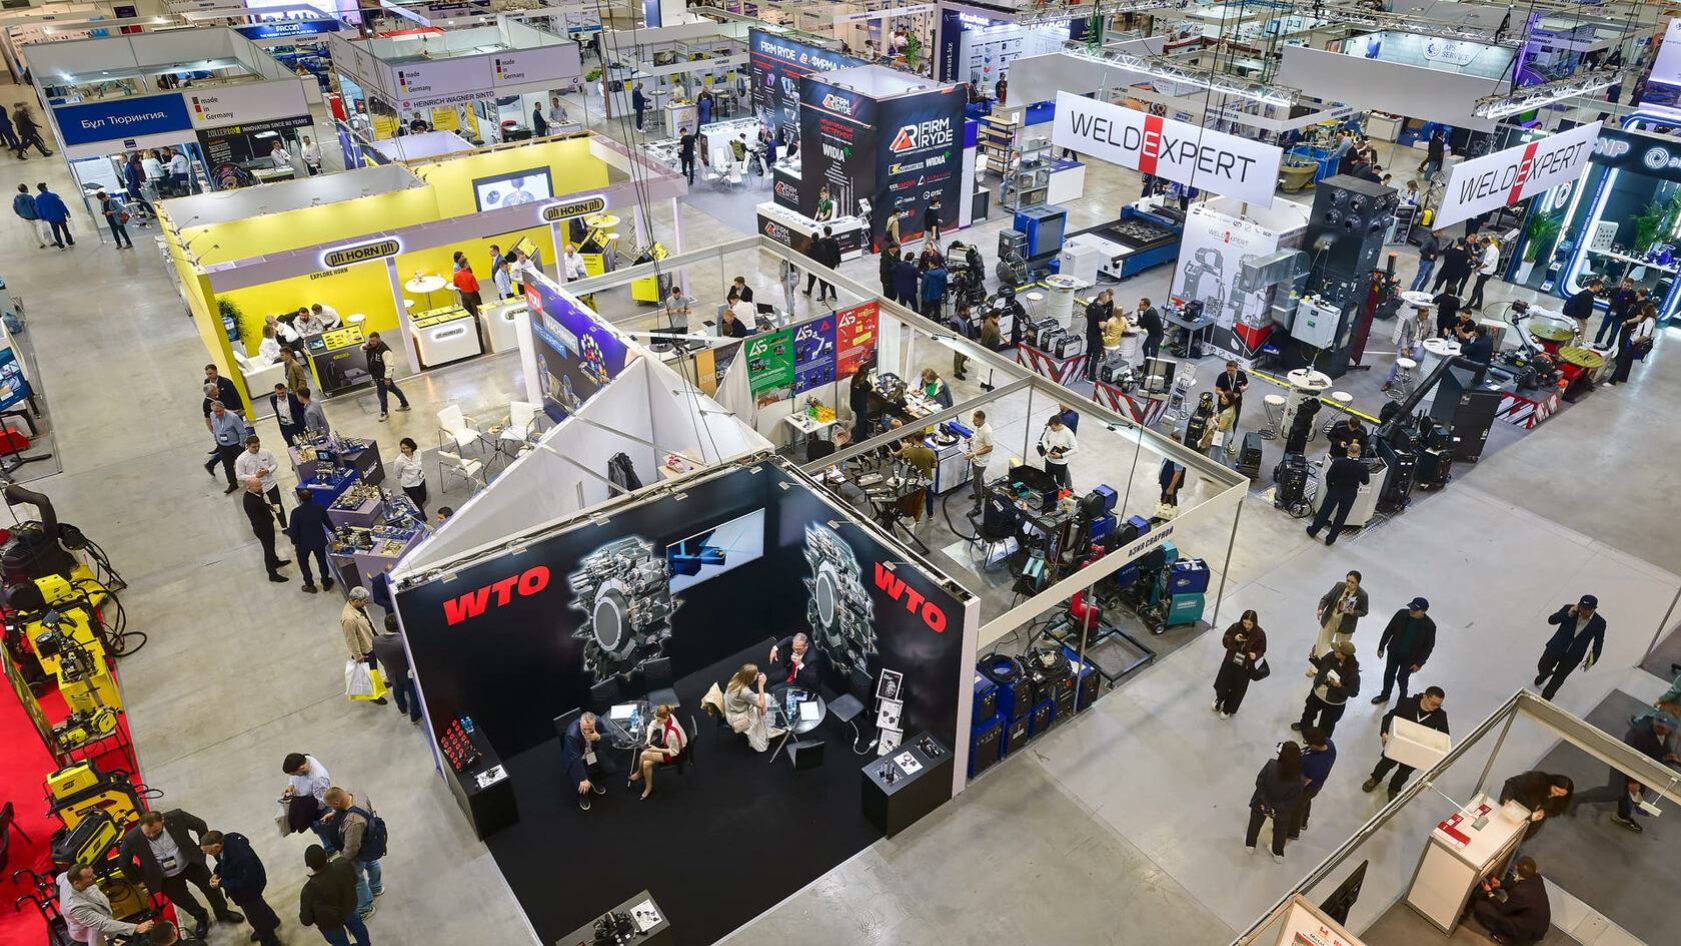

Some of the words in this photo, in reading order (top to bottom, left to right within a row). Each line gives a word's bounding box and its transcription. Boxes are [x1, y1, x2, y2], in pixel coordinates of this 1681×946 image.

[503, 71, 525, 80] Germany
[408, 84, 432, 93] Germany
[200, 96, 218, 104] made
[413, 97, 446, 108] HEINRICH
[445, 94, 475, 104] WAGNER
[475, 91, 495, 99] SINTO
[206, 111, 234, 120] Germany
[242, 124, 271, 132] INNOVATION
[921, 117, 950, 135] FIRM
[921, 129, 954, 148] RYDE
[822, 143, 845, 162] WIDIA
[1071, 110, 1257, 183] WELDEXPERT
[926, 155, 946, 168] WIDIA
[1459, 141, 1587, 205] WELDEXPERT
[560, 203, 588, 215] HORN
[346, 245, 380, 260] HORN
[310, 269, 334, 281] EXPLORE
[334, 266, 349, 276] HORN
[443, 565, 550, 626] WTO
[874, 561, 947, 633] WTO
